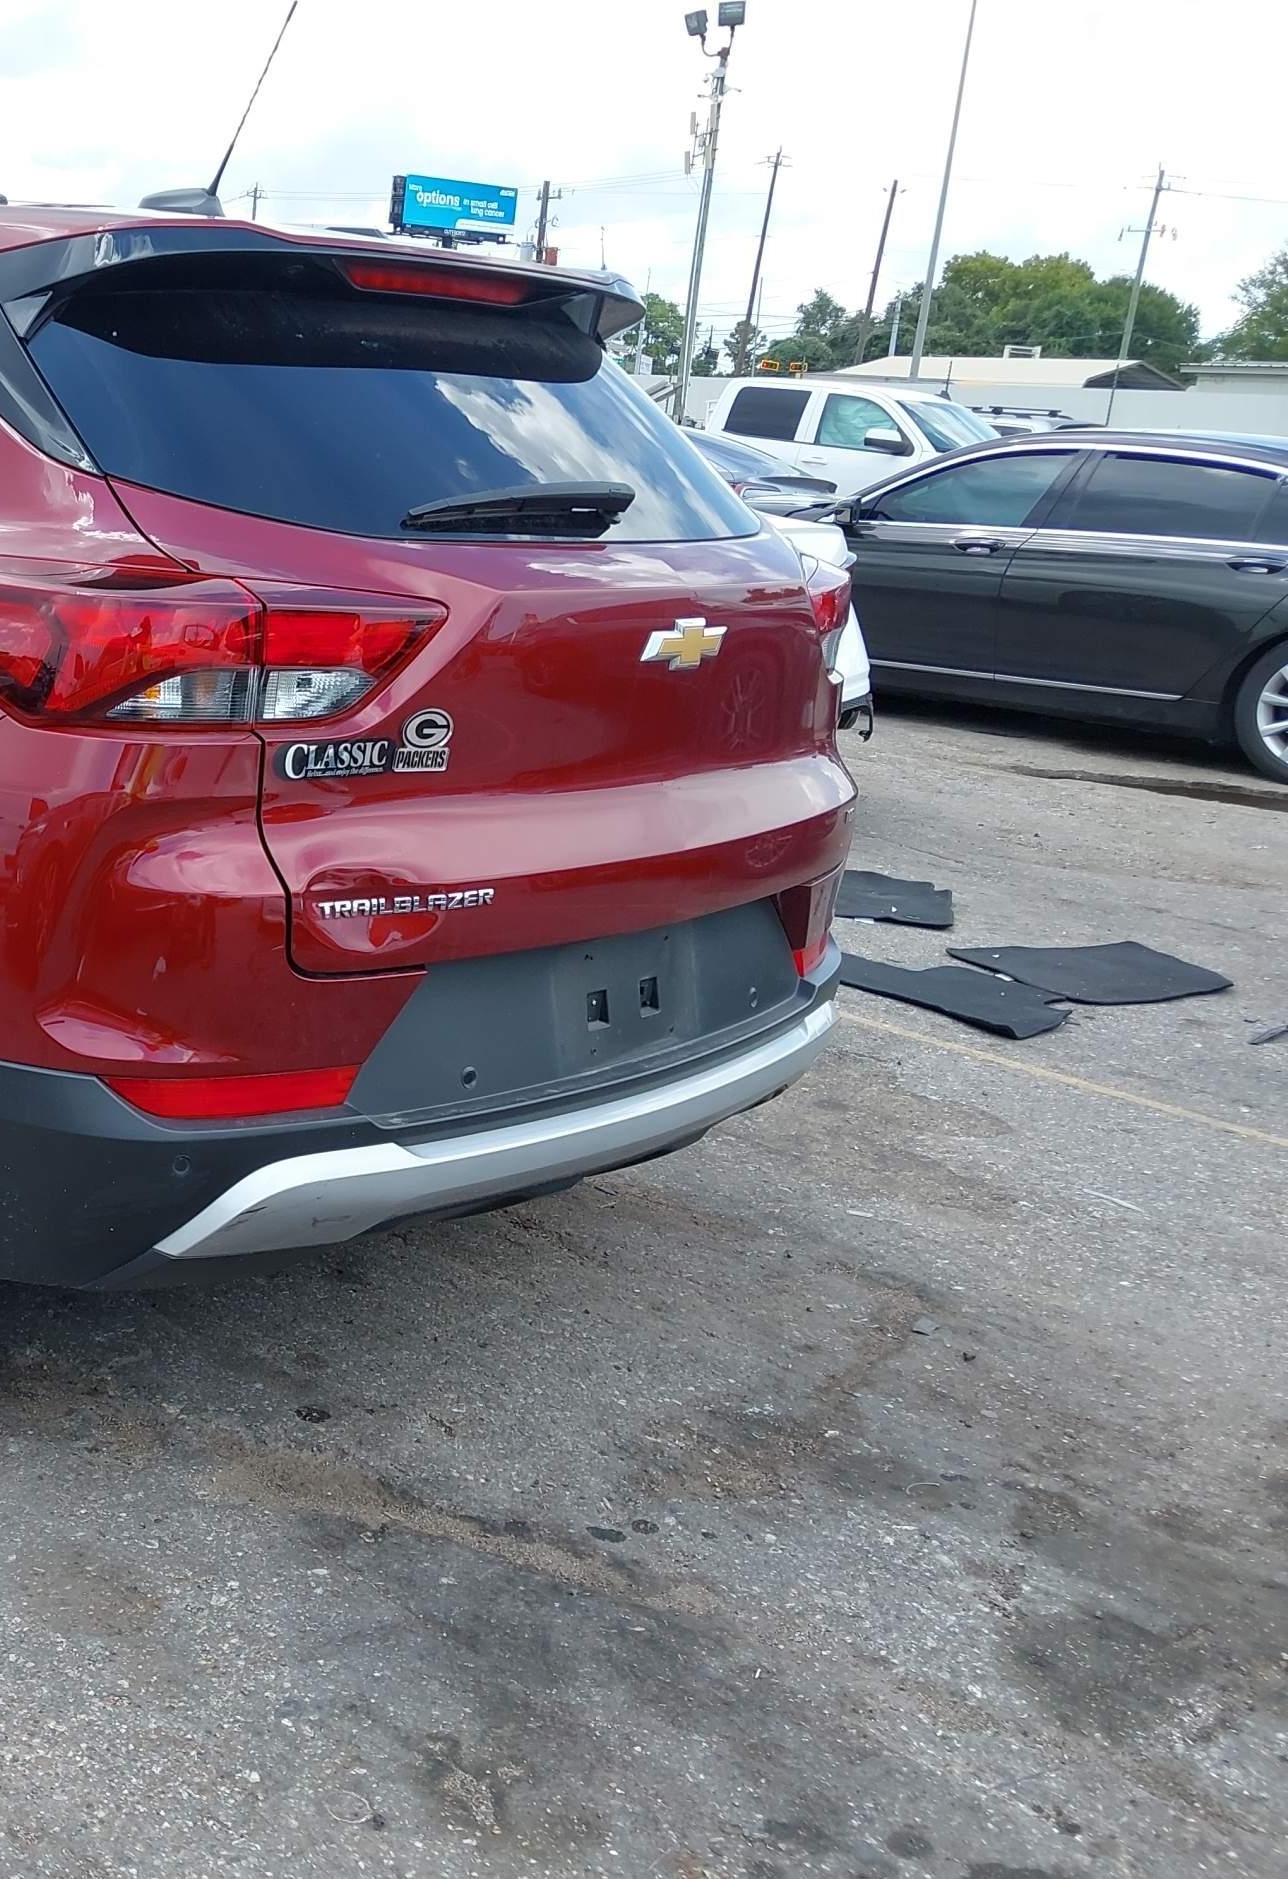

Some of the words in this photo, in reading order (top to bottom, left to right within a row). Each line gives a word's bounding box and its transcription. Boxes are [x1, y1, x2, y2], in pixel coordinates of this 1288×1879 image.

[416, 190, 460, 207] options
[470, 199, 486, 208] small
[470, 206, 483, 217] lung
[484, 208, 505, 218] cancer
[285, 740, 388, 780] CLASSIC
[395, 750, 447, 768] PACKERS
[318, 887, 496, 920] TRAILBLAZER
